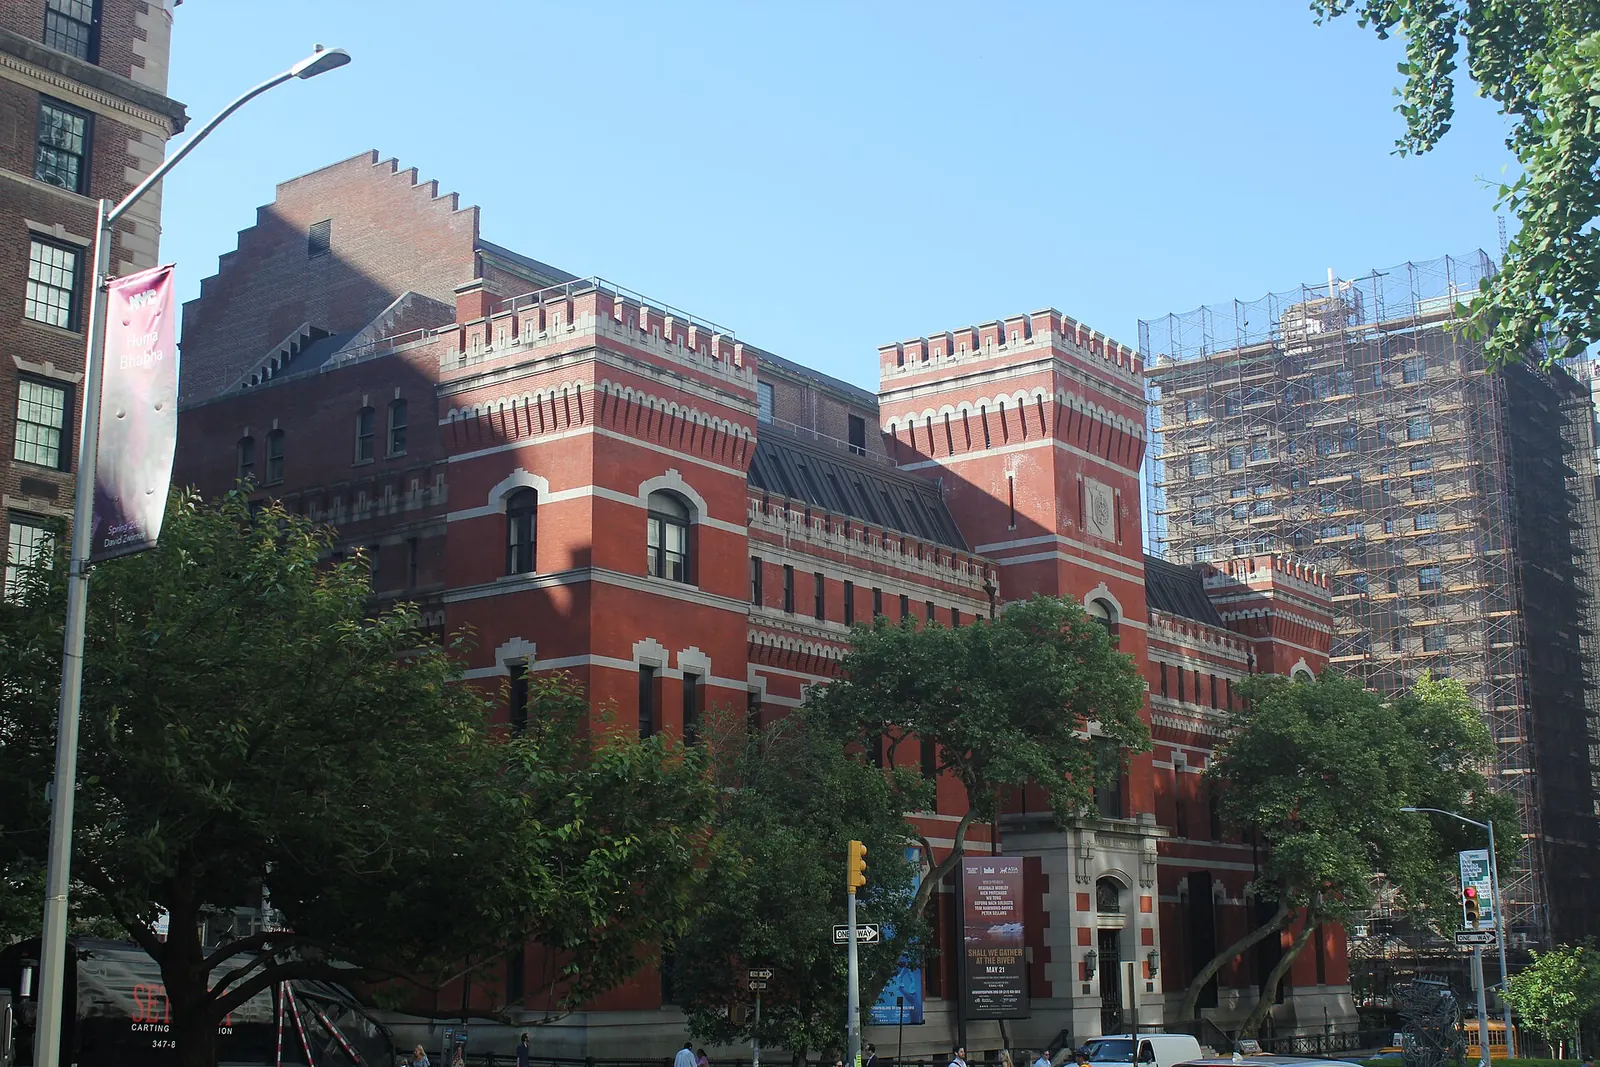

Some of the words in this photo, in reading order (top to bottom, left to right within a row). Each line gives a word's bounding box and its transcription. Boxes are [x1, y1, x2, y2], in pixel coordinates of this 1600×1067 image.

[126, 331, 159, 348] Huma
[120, 348, 163, 370] Bhabha
[108, 524, 128, 536] Spring
[104, 532, 122, 548] David
[837, 930, 849, 938] ONE
[968, 949, 988, 957] SHALL
[988, 949, 999, 957] WE
[999, 949, 1023, 957] GATHER
[975, 957, 983, 965] AT
[983, 957, 997, 965] THE
[996, 957, 1016, 965] RIVER
[131, 1023, 170, 1032] CARTING
